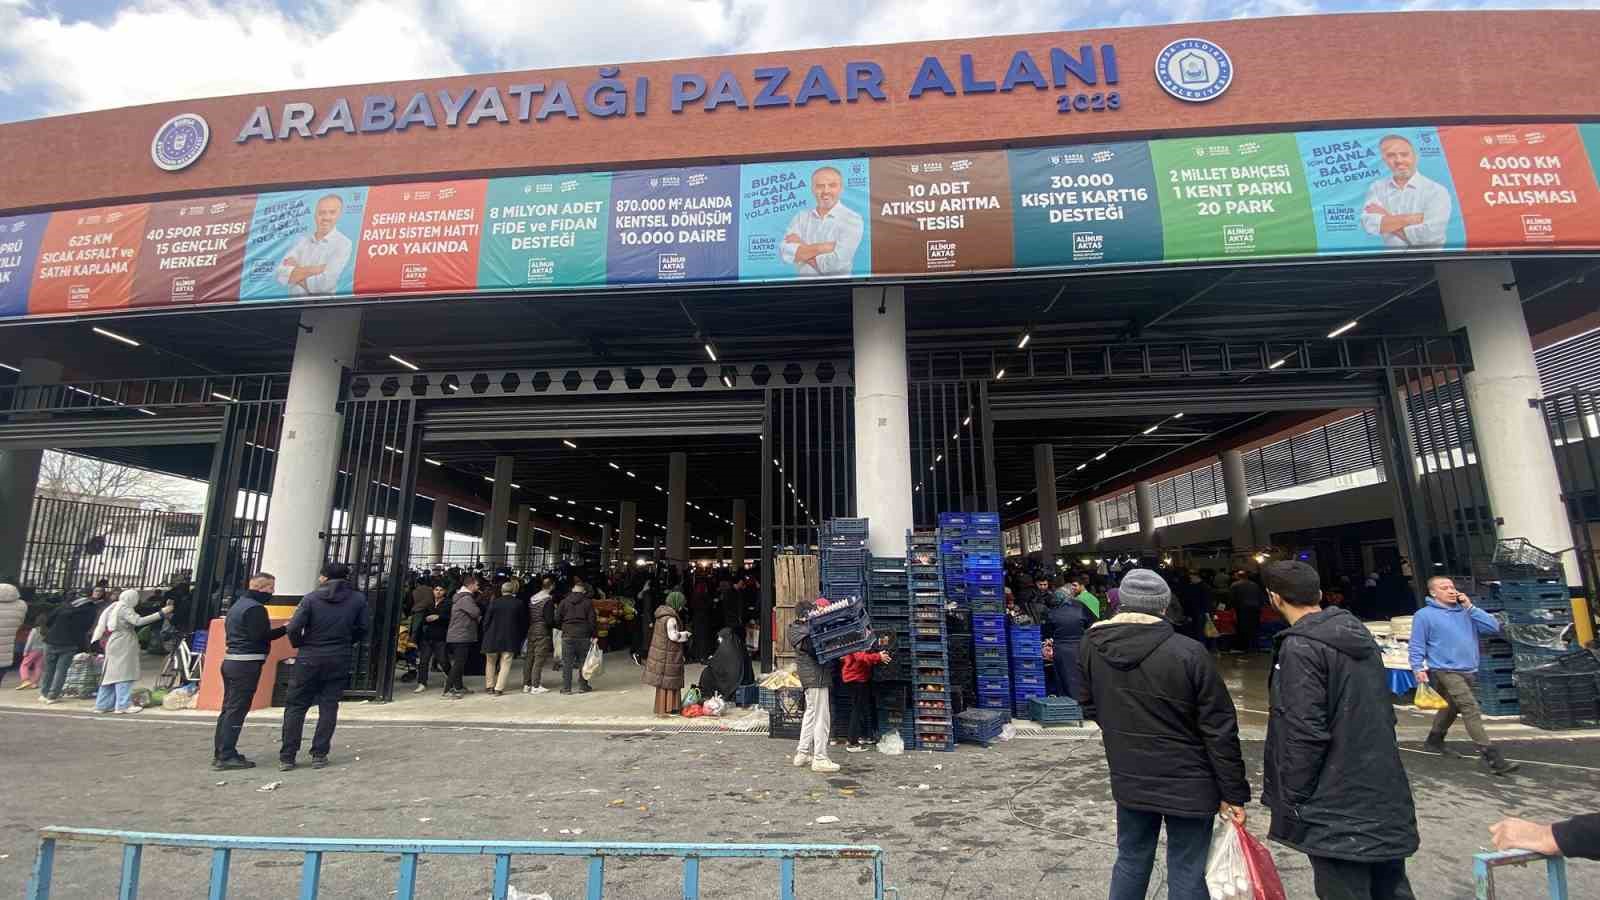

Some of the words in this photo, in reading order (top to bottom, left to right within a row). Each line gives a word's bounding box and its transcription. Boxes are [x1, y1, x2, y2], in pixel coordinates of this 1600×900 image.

[233, 66, 649, 144] ARABAYATAĞI
[671, 62, 888, 114] PAZAR
[910, 45, 1120, 99] ALANI
[1057, 92, 1121, 113] 2023
[1312, 139, 1363, 158] BURSA
[1324, 148, 1376, 166] CANLA
[1320, 160, 1368, 178] BAŞLA
[1479, 156, 1532, 171] 4.000
[1535, 155, 1562, 170] KM
[751, 171, 797, 189] BURSA
[1051, 173, 1115, 189] 30.000
[1169, 170, 1180, 183] 2
[1181, 167, 1228, 182] MİLLET
[1231, 164, 1291, 182] BAHÇESİ
[1312, 176, 1342, 189] YOLA
[1344, 168, 1382, 183] DEVAM
[1491, 173, 1561, 187] ALTYAPI
[759, 179, 806, 197] CANLA
[908, 184, 926, 197] 10
[930, 181, 971, 196] ADET
[1082, 188, 1149, 205] KART16
[1173, 186, 1182, 199] 1
[1186, 183, 1233, 199] KENT
[1236, 179, 1293, 196] PARKI
[616, 199, 666, 212] 870.000
[684, 196, 733, 211] ALANDA
[752, 191, 796, 209] BAŞLA
[881, 200, 936, 216] ATIKSU
[939, 196, 1001, 213] ARITMA
[1483, 189, 1578, 207] ÇALIŞMASI
[489, 209, 500, 219] 8
[503, 203, 559, 218] MİLYON
[561, 201, 604, 215] ADET
[744, 208, 771, 221] YOLA
[772, 200, 808, 214] DEVAM
[1049, 204, 1125, 224] DESTEĞİ
[1198, 203, 1221, 216] 20
[1225, 199, 1276, 215] PARK
[492, 220, 527, 235] FİDE
[530, 221, 547, 233] ve
[551, 216, 598, 231] FİDAN
[616, 214, 670, 230] KENTSEL
[671, 211, 733, 229] DÖNÜŞÜM
[917, 215, 965, 231] TESİSİ
[69, 235, 92, 248] 625
[93, 232, 114, 246] KM
[147, 229, 164, 241] 40
[168, 226, 202, 240] SPOR
[363, 228, 397, 242] RAYLI
[444, 223, 480, 238] HATTI
[620, 230, 675, 245] 10.000
[679, 229, 727, 244] DAİRE
[156, 243, 170, 255] 15
[368, 243, 398, 259] ÇOK
[403, 240, 470, 255] YAKINDA
[511, 234, 577, 251] DESTEĞİ
[42, 250, 75, 264] SICAK
[76, 247, 119, 262] ASFALT
[160, 254, 219, 270] MERKEZİ
[72, 261, 129, 277] KAPLAMA
